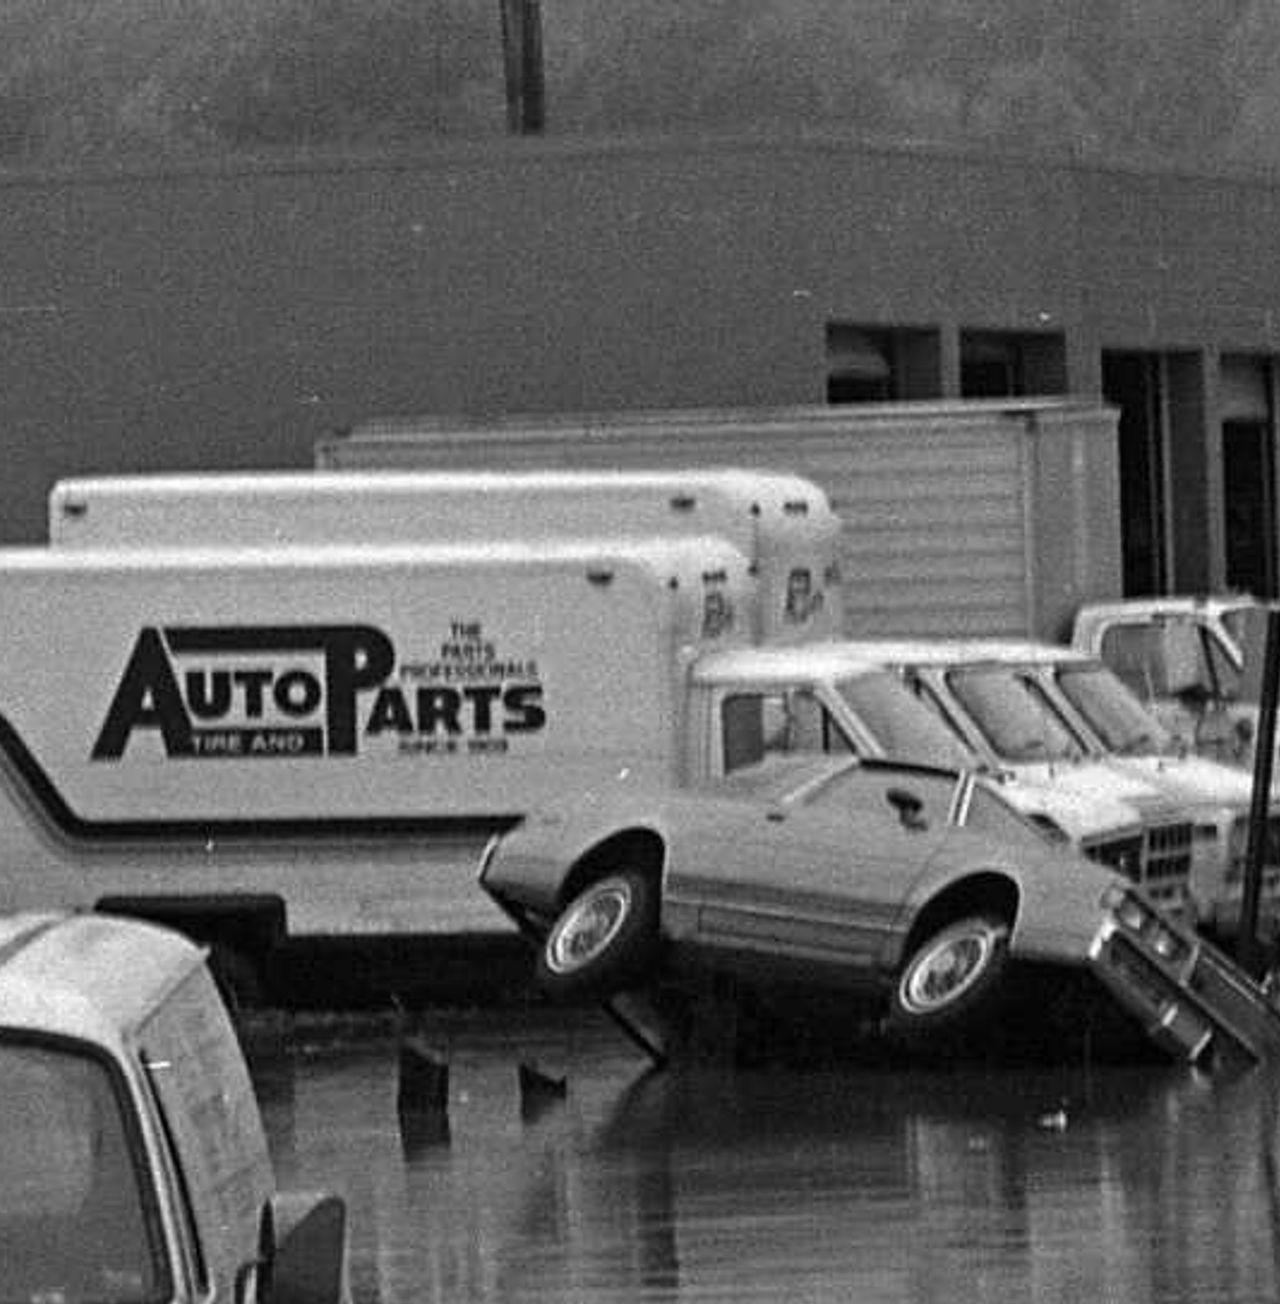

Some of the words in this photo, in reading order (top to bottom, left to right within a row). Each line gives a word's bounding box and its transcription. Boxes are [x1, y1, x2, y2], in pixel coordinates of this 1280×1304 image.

[91, 626, 322, 760] AUTO
[324, 626, 547, 757] PARTS
[192, 733, 242, 754] TIRE
[251, 733, 306, 754] AND
